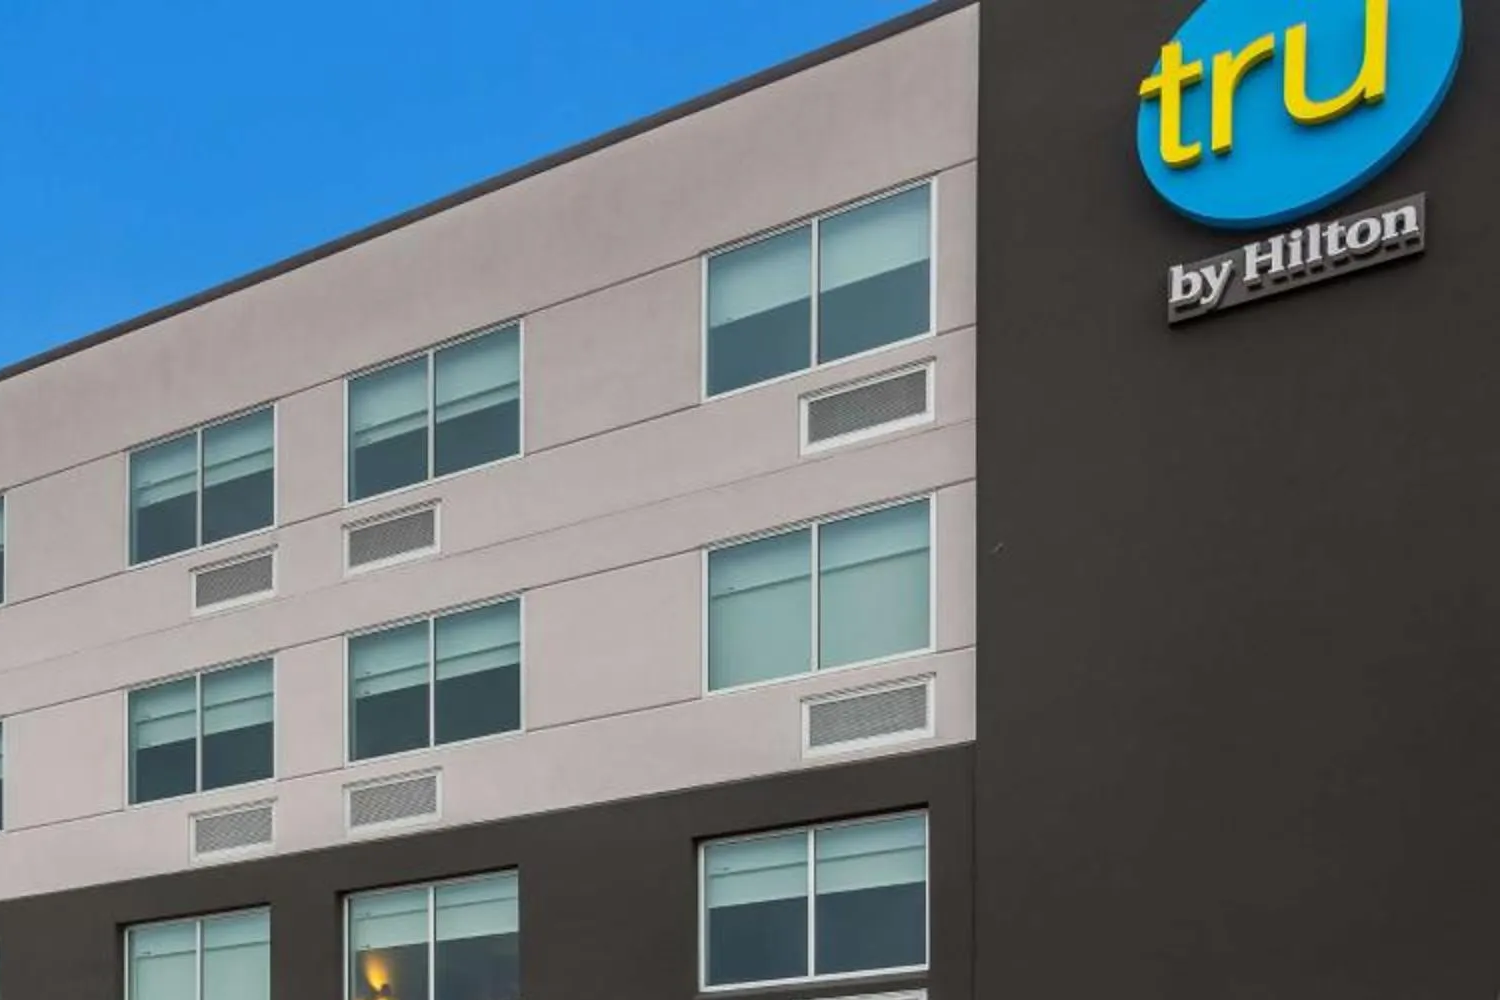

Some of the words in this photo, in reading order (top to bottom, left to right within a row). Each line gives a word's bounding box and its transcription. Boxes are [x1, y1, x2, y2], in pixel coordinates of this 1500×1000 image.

[1138, 0, 1389, 168] tru
[1169, 261, 1234, 307] by
[1243, 203, 1421, 284] Hilton
